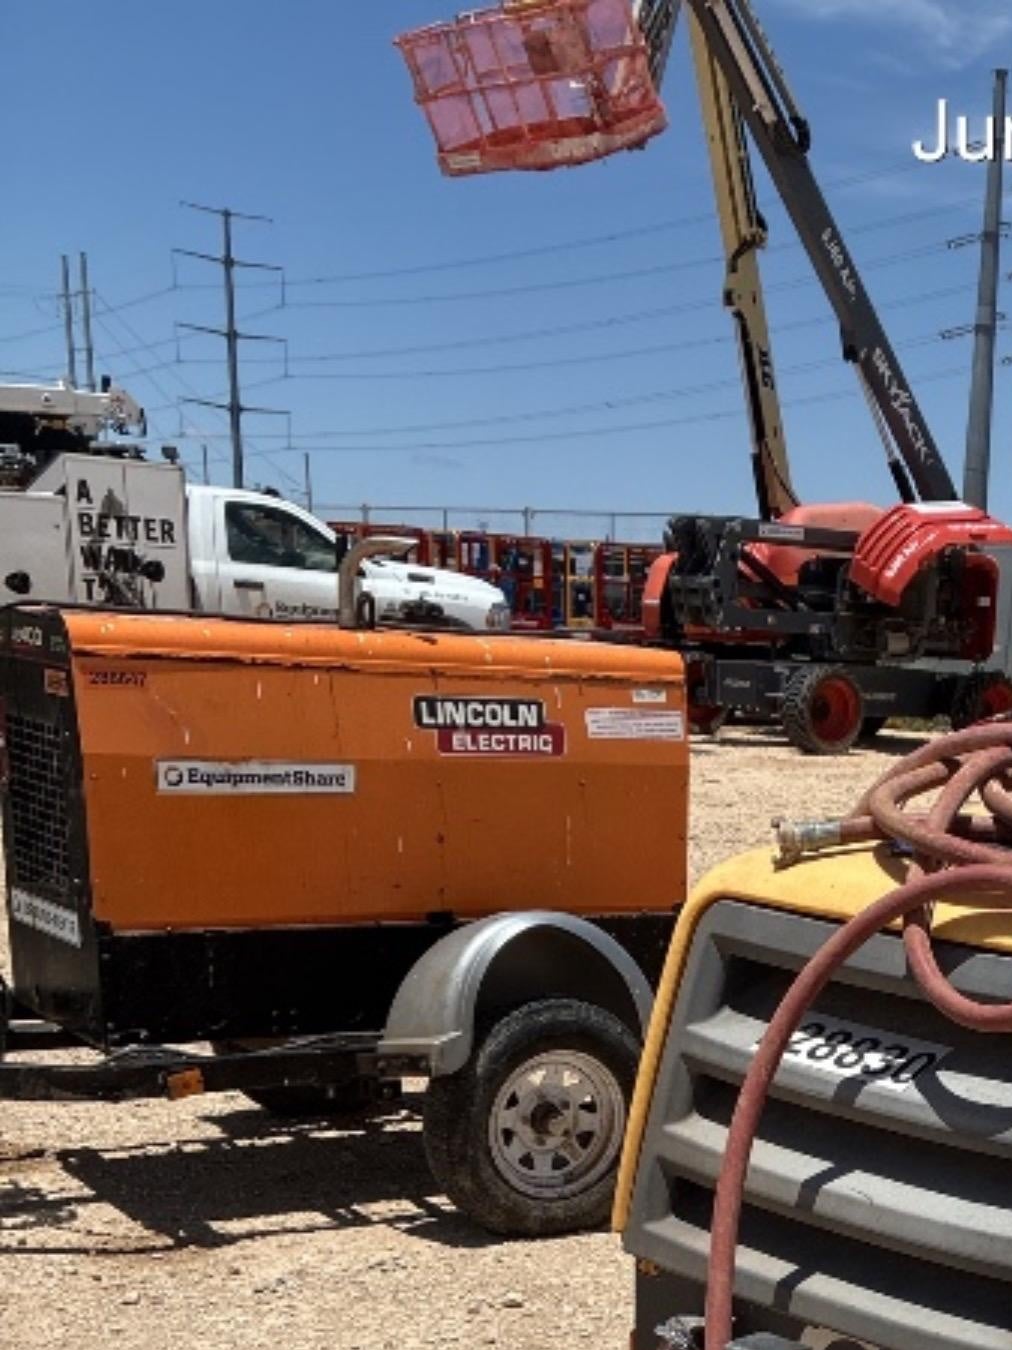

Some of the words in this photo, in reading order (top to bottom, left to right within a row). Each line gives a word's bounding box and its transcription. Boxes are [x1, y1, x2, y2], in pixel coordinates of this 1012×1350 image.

[77, 479, 93, 504] A
[78, 512, 175, 543] BETTER
[419, 701, 538, 727] LINCOLN
[452, 734, 553, 753] ELECTRIC
[187, 767, 346, 788] EquipmentShare
[756, 1022, 937, 1083] 28830
